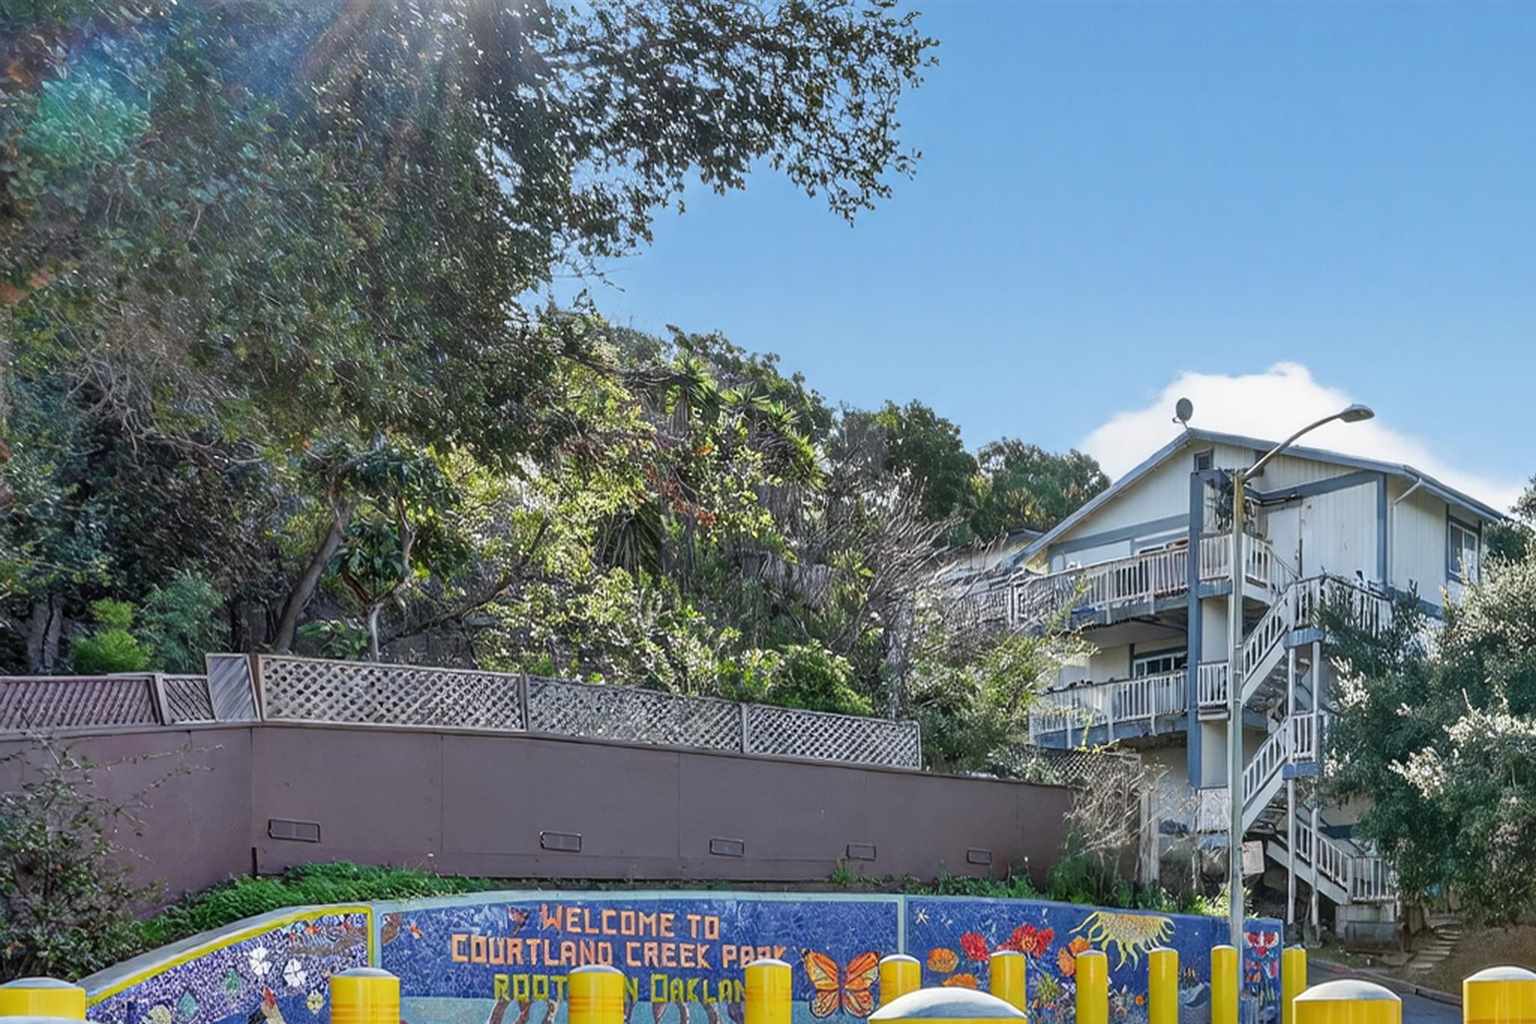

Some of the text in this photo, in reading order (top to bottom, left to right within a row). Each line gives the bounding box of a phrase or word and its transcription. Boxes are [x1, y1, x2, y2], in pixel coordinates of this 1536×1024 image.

[539, 903, 719, 940] WELCOME TO
[451, 933, 613, 968] COURTLAND
[626, 941, 711, 969] CREEK
[494, 973, 569, 1003] ROOT
[651, 973, 746, 1004] OAKLAN
